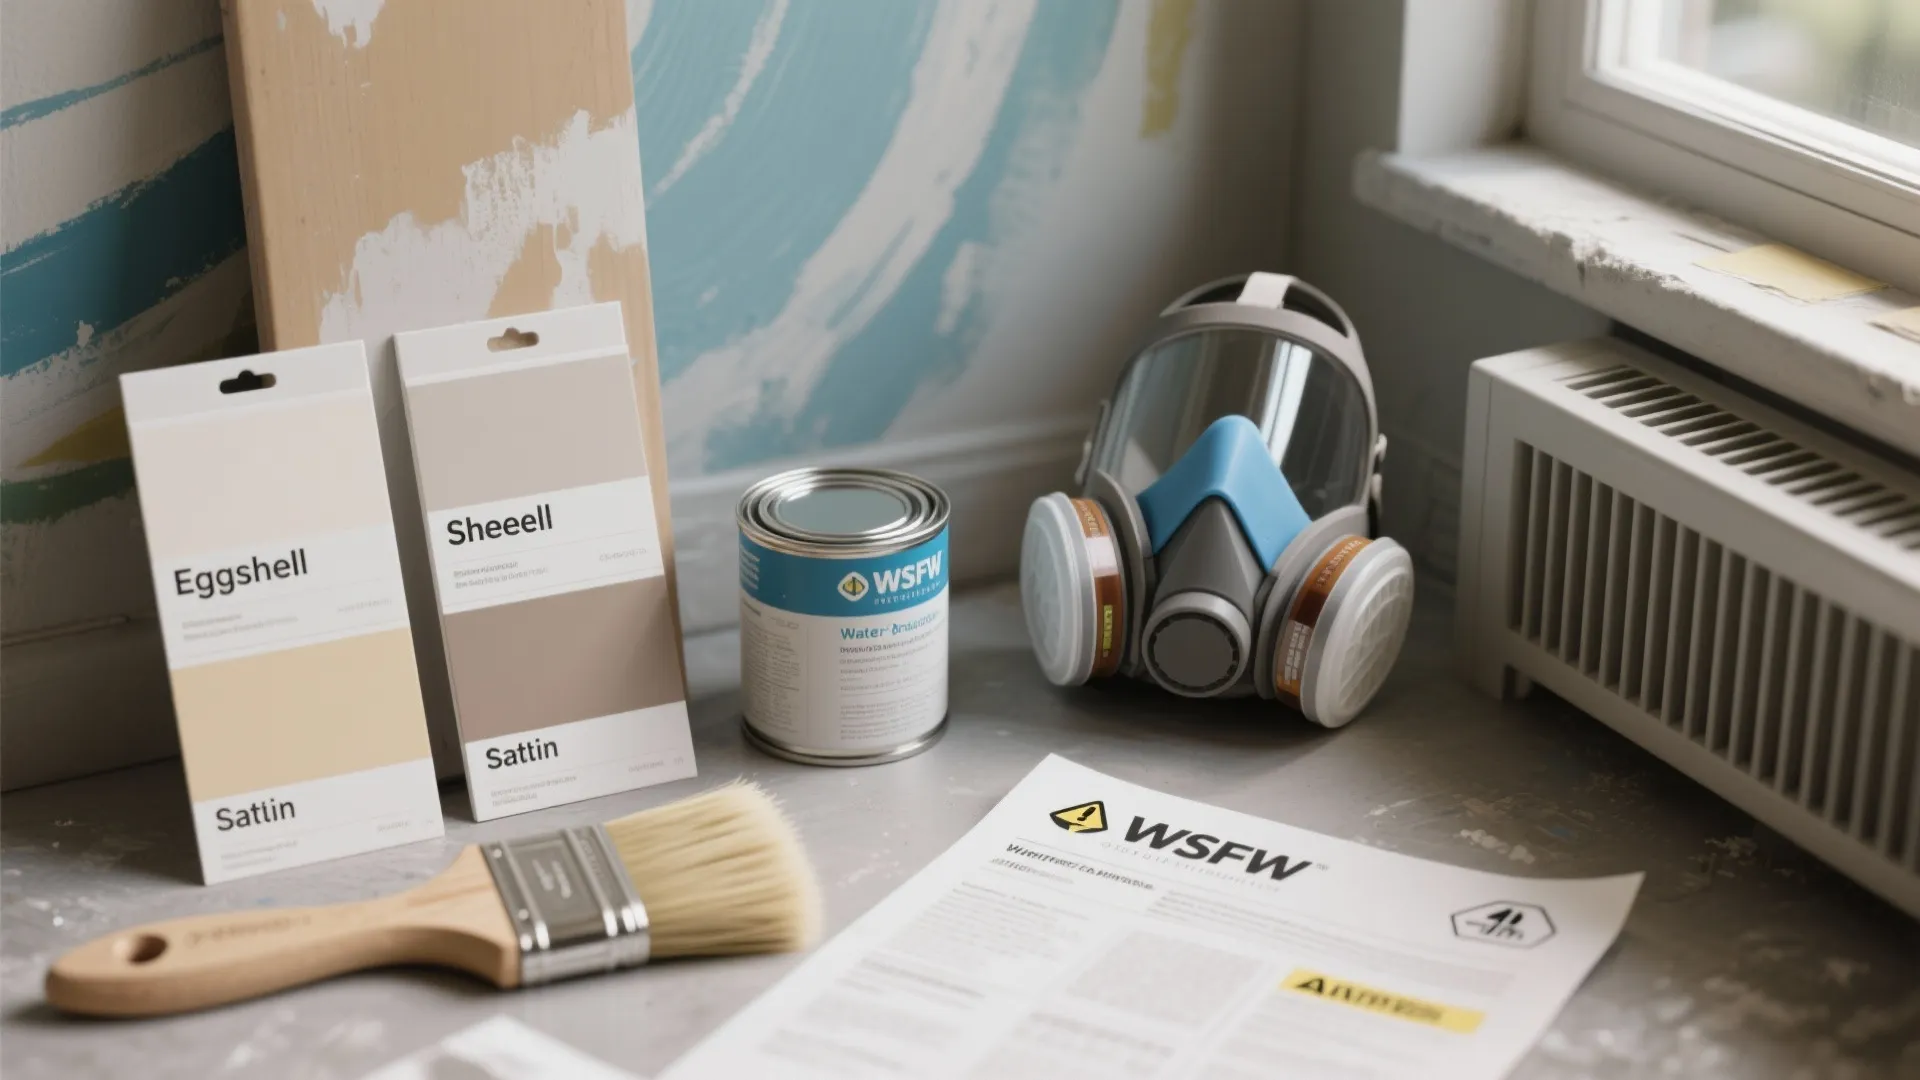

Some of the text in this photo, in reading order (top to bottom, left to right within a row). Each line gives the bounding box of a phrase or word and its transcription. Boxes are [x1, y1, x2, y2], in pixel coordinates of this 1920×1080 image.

[447, 503, 553, 546] Sheeell
[174, 548, 308, 599] Eggshell
[872, 550, 943, 595] WSFW
[485, 738, 559, 770] Sattin
[1124, 815, 1313, 881] WSFW
